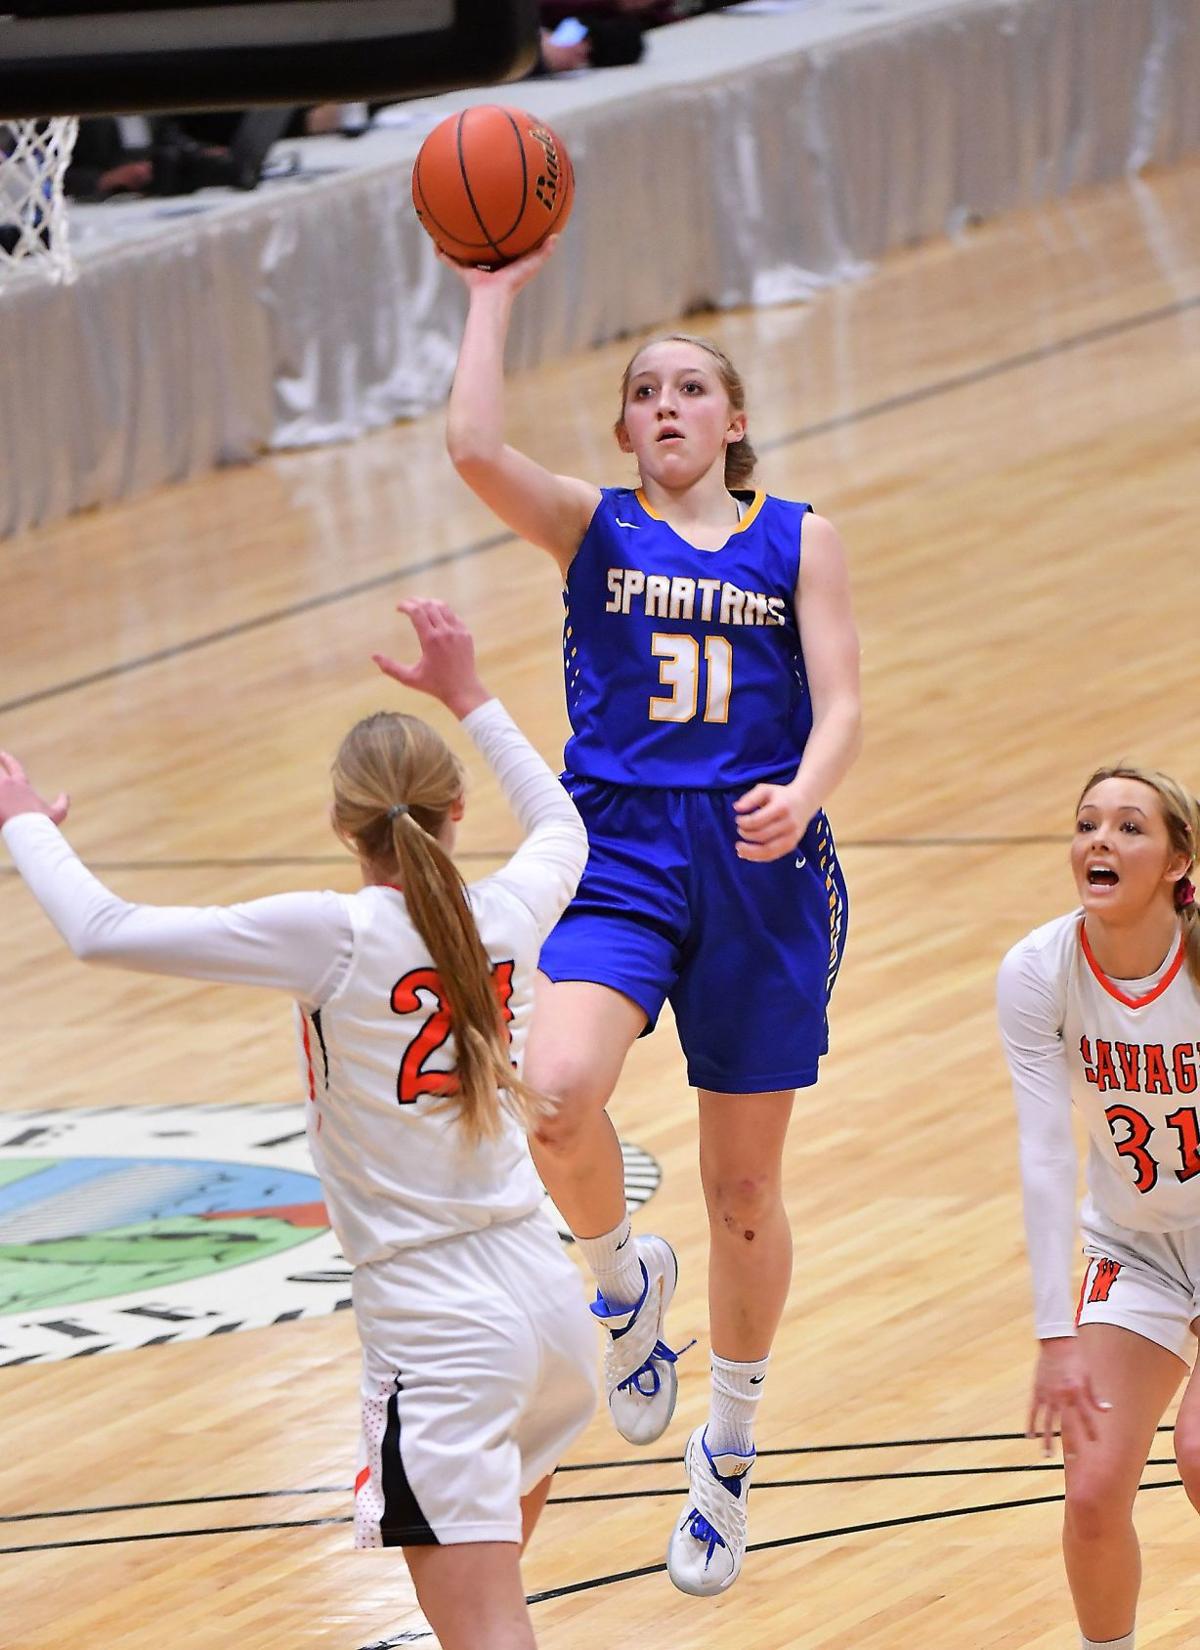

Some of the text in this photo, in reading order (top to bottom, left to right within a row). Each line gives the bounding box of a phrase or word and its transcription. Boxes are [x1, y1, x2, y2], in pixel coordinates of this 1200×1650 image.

[605, 567, 786, 627] SPARTANS
[649, 632, 733, 724] 31
[1080, 1034, 1200, 1095] SAVAG
[1104, 1104, 1200, 1194] 31
[1088, 1258, 1122, 1303] W
